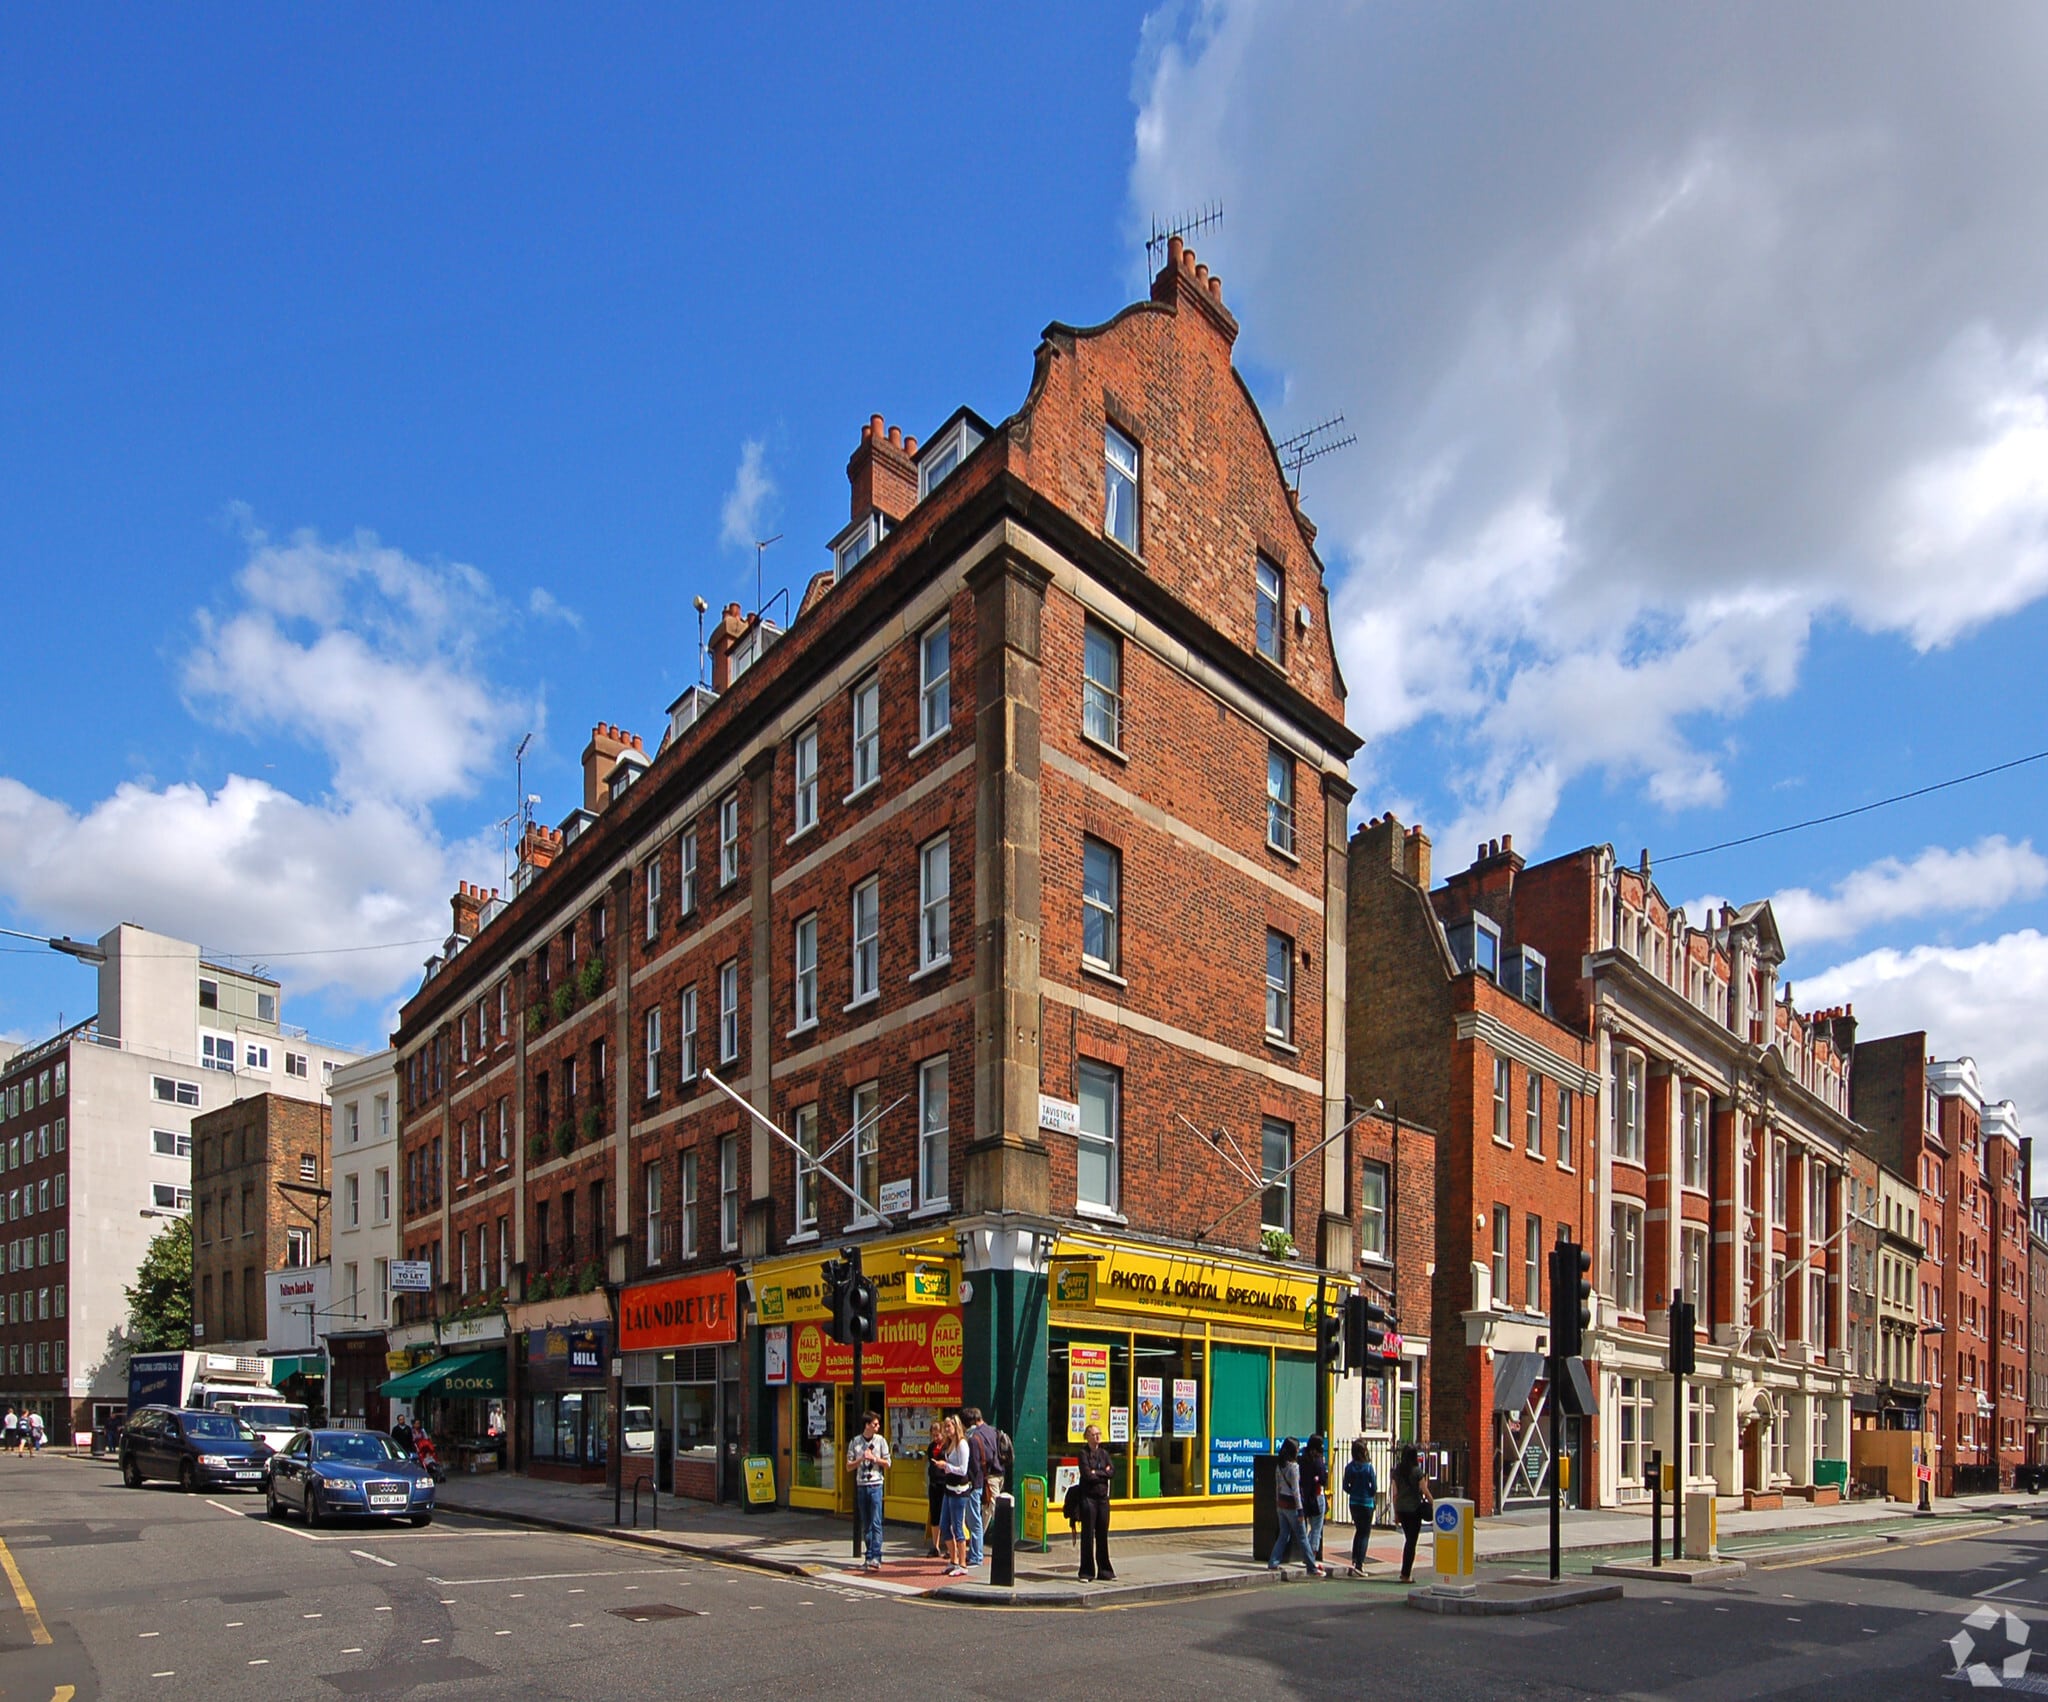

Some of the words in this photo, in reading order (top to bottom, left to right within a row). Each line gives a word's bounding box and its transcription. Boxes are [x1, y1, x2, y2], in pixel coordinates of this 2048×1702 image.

[1042, 1105, 1075, 1122] TAVISTOCK
[1042, 1114, 1060, 1128] PLACE
[881, 1189, 910, 1202] MARCHMONT
[881, 1201, 898, 1212] STREET
[787, 1285, 812, 1301] PHOTO
[814, 1284, 820, 1297] &
[1111, 1270, 1157, 1293] PHOTO
[1162, 1277, 1171, 1295] &
[1174, 1279, 1221, 1301] DIGITAL
[1226, 1286, 1298, 1312] SPECIALISTS
[626, 1293, 728, 1331] LAUNDRETTE
[878, 1320, 927, 1347] rinting
[935, 1327, 961, 1341] HALF
[800, 1337, 820, 1349] HALF
[799, 1352, 821, 1364] PRICE
[934, 1345, 962, 1358] PRICE
[573, 1352, 598, 1366] HILL
[825, 1355, 854, 1367] Exhibitio
[445, 1378, 494, 1390] BOOKS
[901, 1382, 923, 1394] Order
[924, 1382, 950, 1394] Online
[1215, 1439, 1242, 1450] Passport
[1243, 1440, 1263, 1449] Photos
[1217, 1453, 1232, 1463] Slide
[1212, 1469, 1231, 1479] Photo
[1232, 1468, 1246, 1479] Gift
